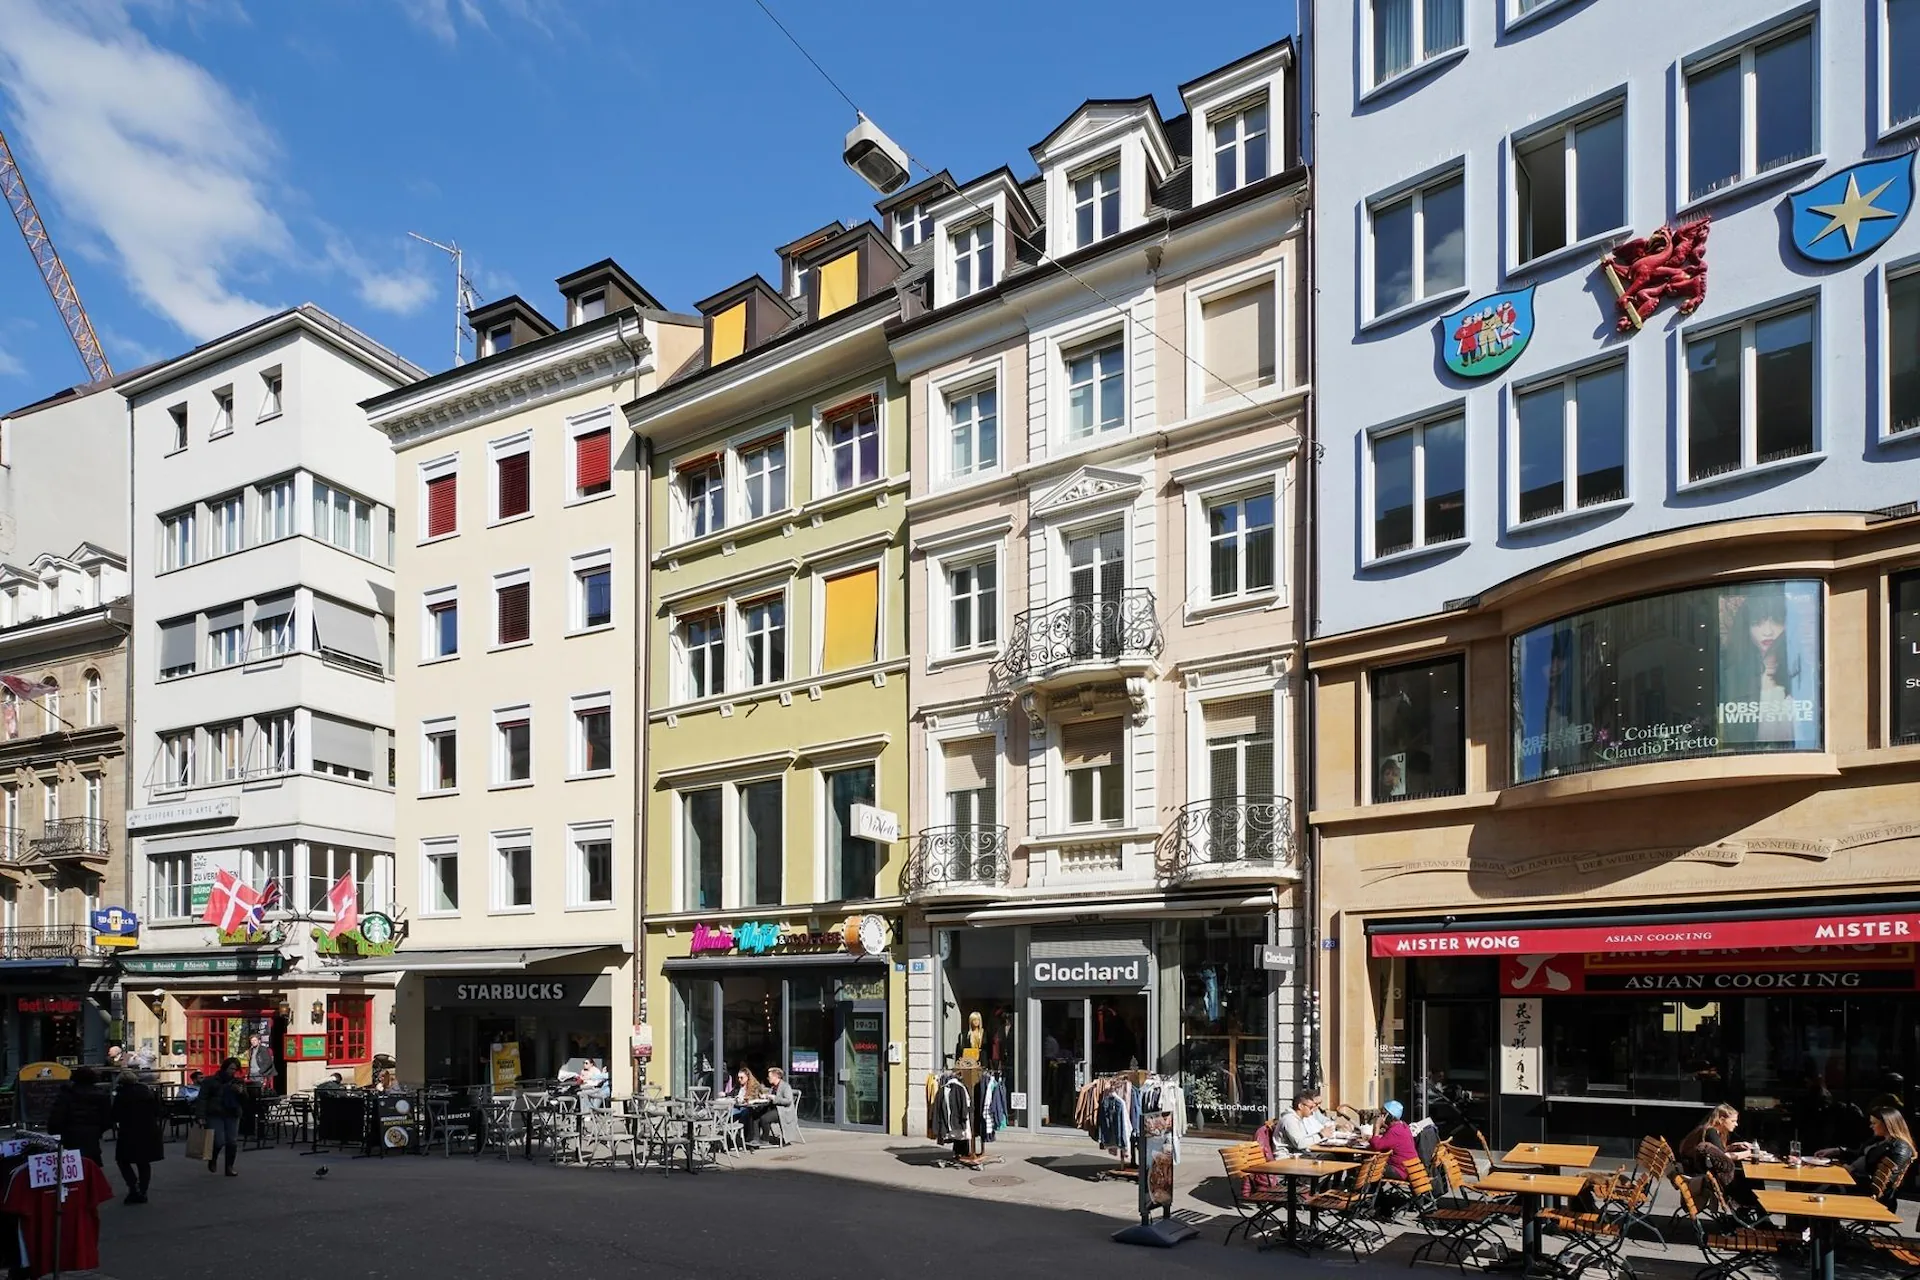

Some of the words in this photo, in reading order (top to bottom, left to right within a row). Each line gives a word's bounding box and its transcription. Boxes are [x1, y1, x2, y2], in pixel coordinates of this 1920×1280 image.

[1724, 700, 1813, 713] OBSESSED
[1725, 712, 1760, 724] WITH
[1762, 711, 1813, 722] STYLE
[1625, 721, 1693, 742] Coiffure
[1603, 740, 1663, 761] Claudio
[1663, 735, 1719, 752] Piretto
[1604, 934, 1644, 943] ASIAN
[1646, 931, 1713, 942] COOKING
[1814, 920, 1910, 939] MISTER
[1324, 941, 1336, 949] 23
[1396, 937, 1460, 951] MISTER
[1465, 935, 1521, 949] WONG
[1265, 951, 1294, 965] Clochard
[1034, 961, 1139, 982] Clochard
[1624, 974, 1706, 989] ASIAN
[1714, 972, 1862, 989] COOKING
[457, 983, 564, 1000] STARBUCKS
[36, 1169, 50, 1183] Fr.
